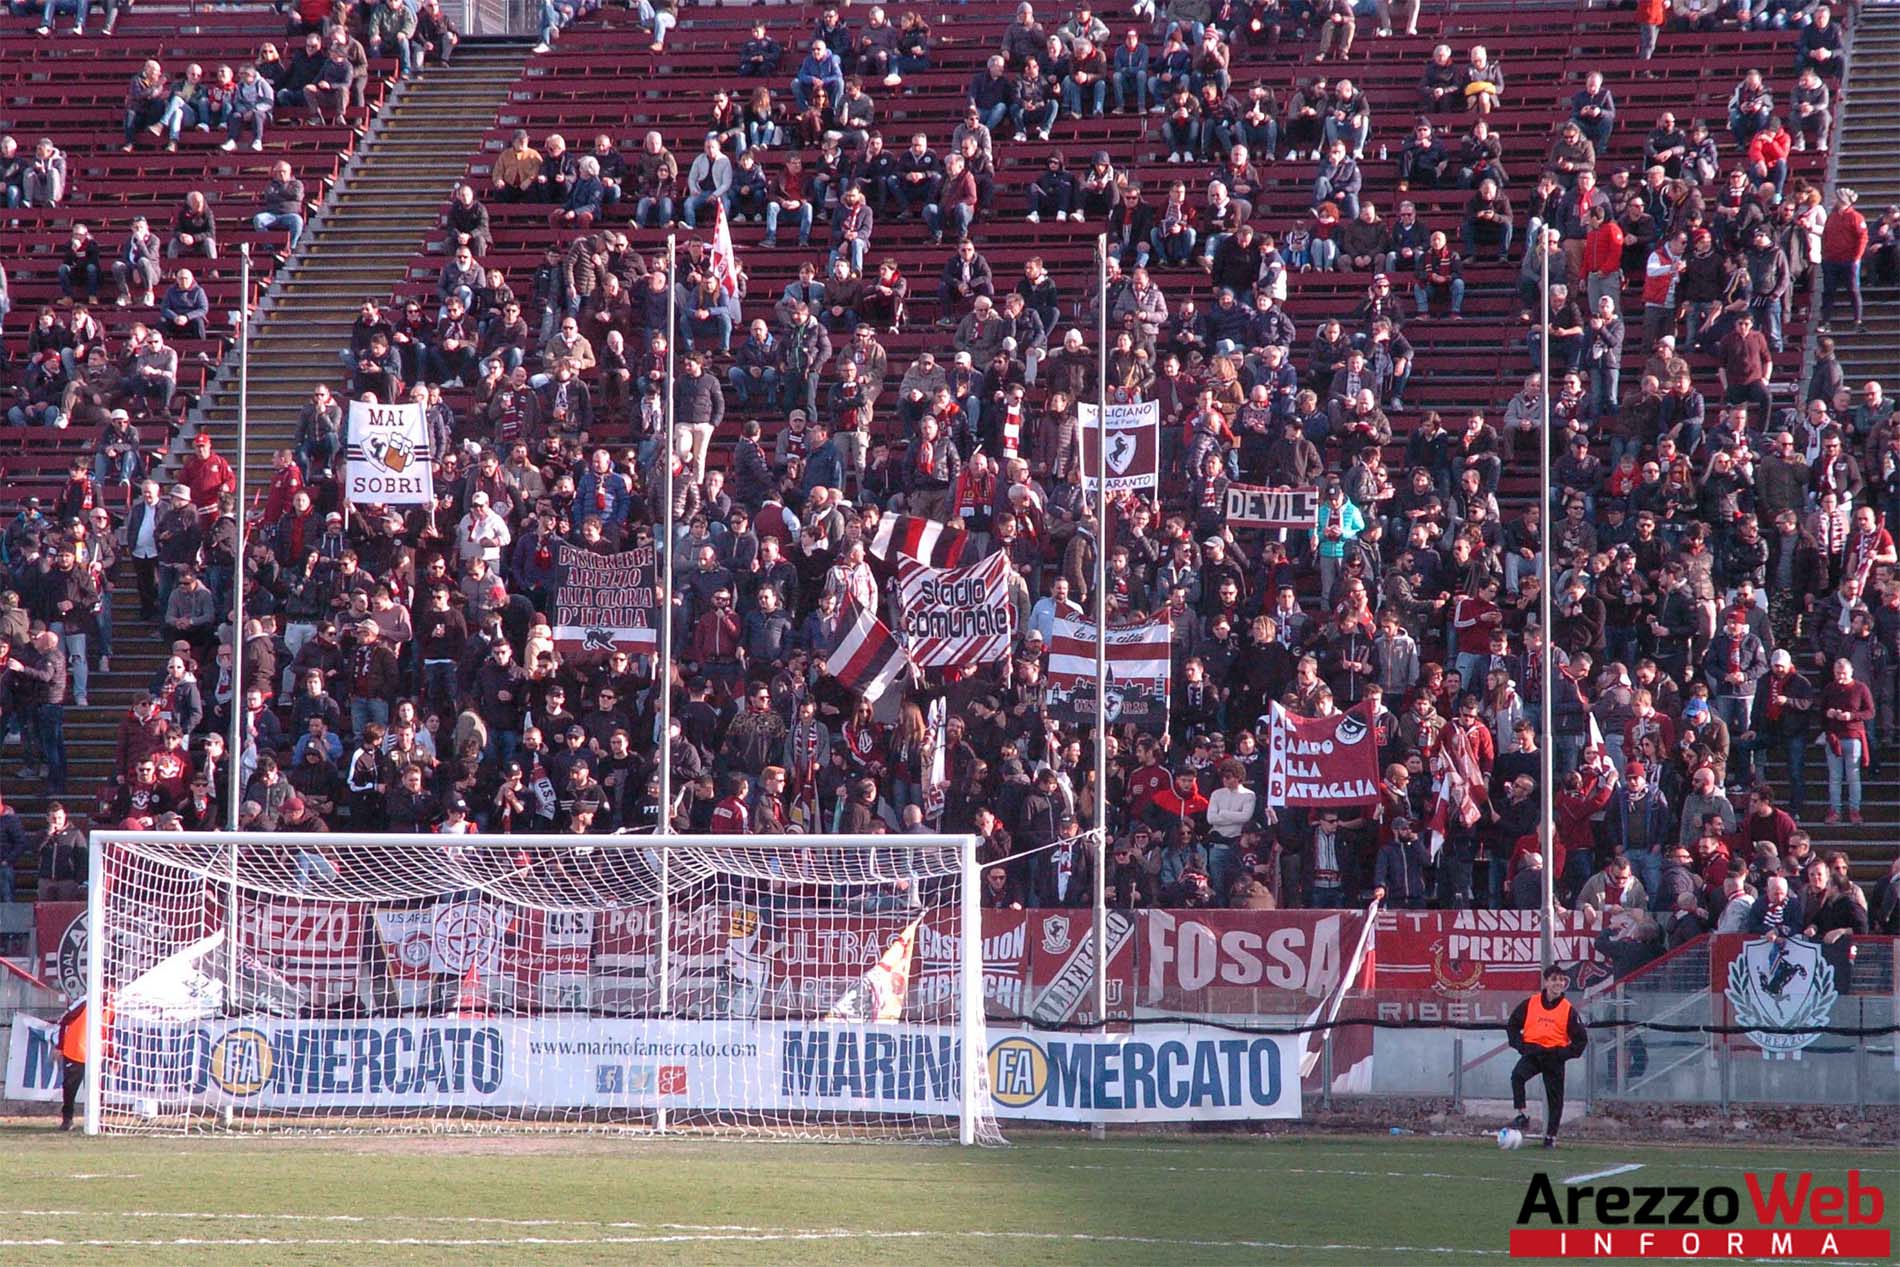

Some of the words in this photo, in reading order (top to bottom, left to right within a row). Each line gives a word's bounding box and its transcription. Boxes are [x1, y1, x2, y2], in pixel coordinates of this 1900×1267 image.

[368, 408, 404, 426] MAI
[353, 477, 422, 493] SOBRI
[1088, 475, 1151, 488] AARANTO
[1227, 488, 1317, 523] DEVILS
[567, 567, 641, 588] AREZZO
[556, 587, 593, 607] ALLA
[595, 588, 653, 609] GLORIA
[222, 907, 349, 951] REZZO
[610, 907, 723, 936] POLERE
[919, 921, 1026, 960] CASTLION
[1149, 909, 1341, 1002] FOSSA
[917, 974, 1022, 1016] FIBOCHI
[1378, 1002, 1511, 1022] RIBELL
[271, 1027, 504, 1094] MERCATO
[530, 1036, 757, 1057] www.marinofamercato.com
[781, 1030, 961, 1101] MARIN
[996, 1047, 1036, 1096] FA
[1045, 1038, 1282, 1109] MERCATO
